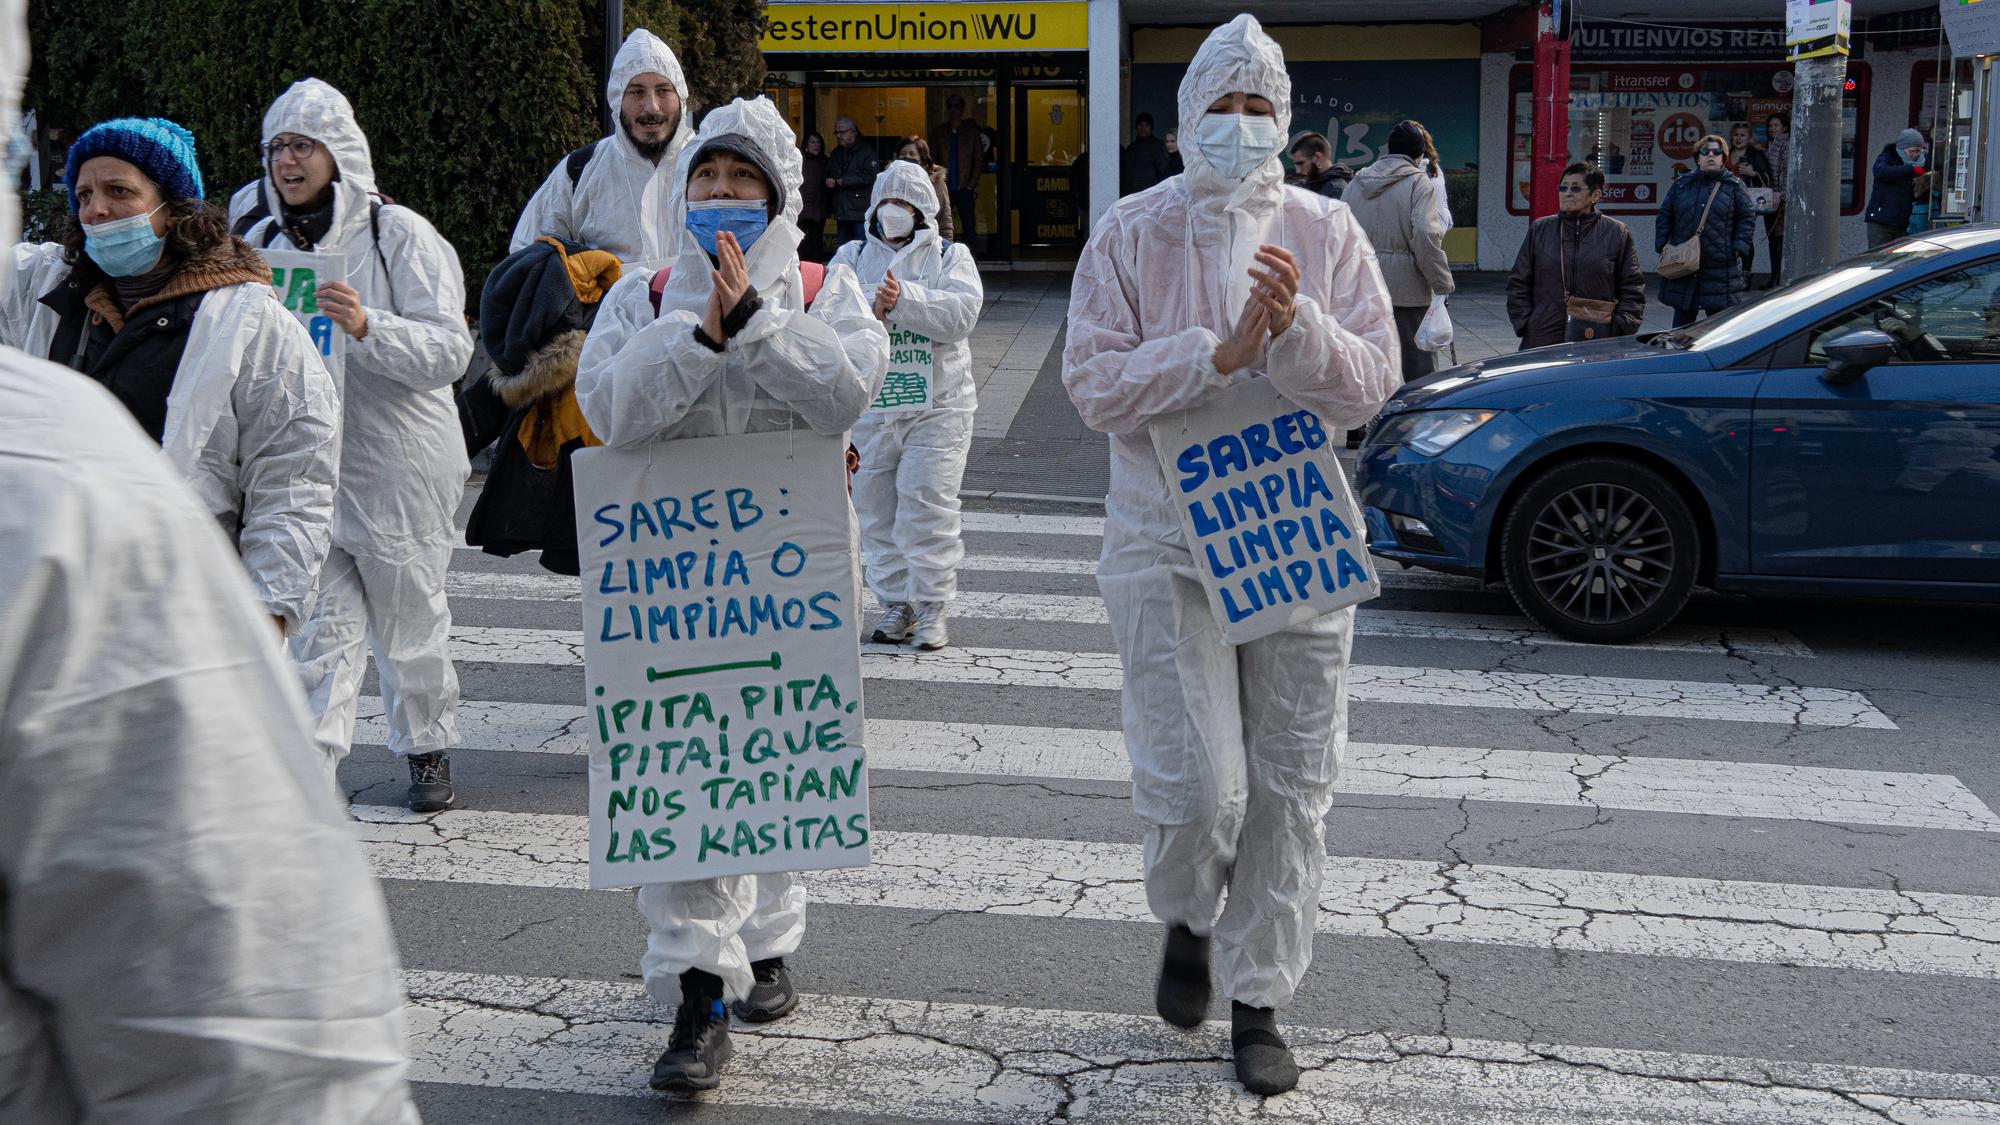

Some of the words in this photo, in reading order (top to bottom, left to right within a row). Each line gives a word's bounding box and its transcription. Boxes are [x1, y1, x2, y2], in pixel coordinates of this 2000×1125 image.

[1600, 186, 1627, 198] sfer
[1176, 409, 1328, 493] SAREB
[594, 487, 789, 547] SAREB:
[1188, 461, 1334, 538] LIMPIA
[770, 541, 809, 577] O
[1205, 508, 1352, 579] LIMPIA
[1219, 548, 1369, 624] LIMPIA
[743, 720, 847, 764] QUE
[608, 785, 686, 820] NOS
[605, 826, 677, 864] LAS
